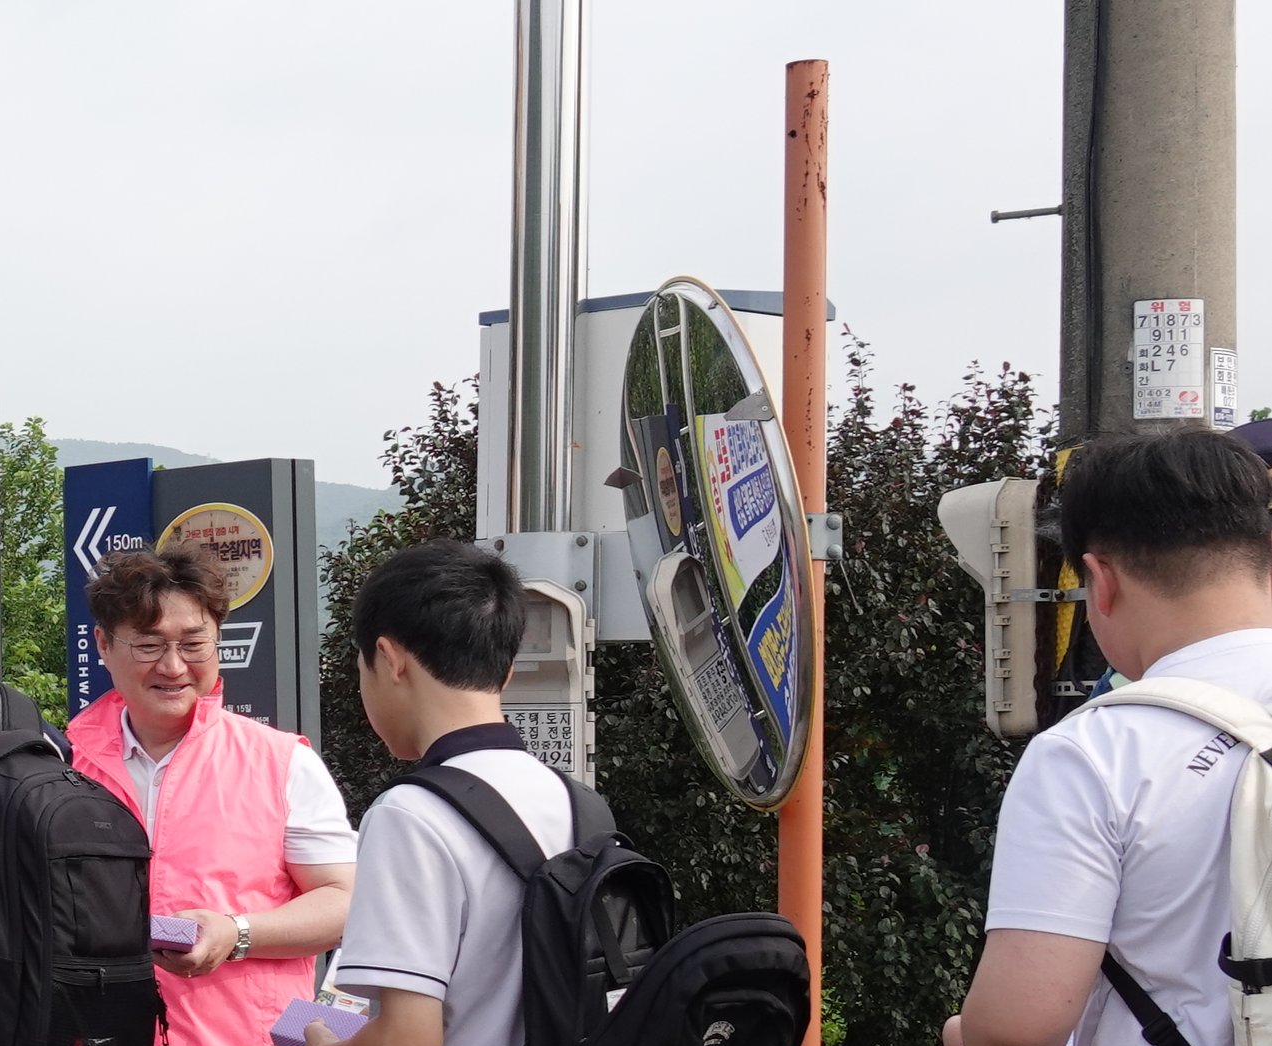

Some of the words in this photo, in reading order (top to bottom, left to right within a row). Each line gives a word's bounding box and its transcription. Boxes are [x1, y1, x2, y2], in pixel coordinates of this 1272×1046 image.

[1152, 329, 1187, 341] 911
[1152, 345, 1189, 357] 246
[105, 534, 143, 551] 150m
[77, 624, 89, 709] HOEHWA
[548, 726, 572, 740] 전문
